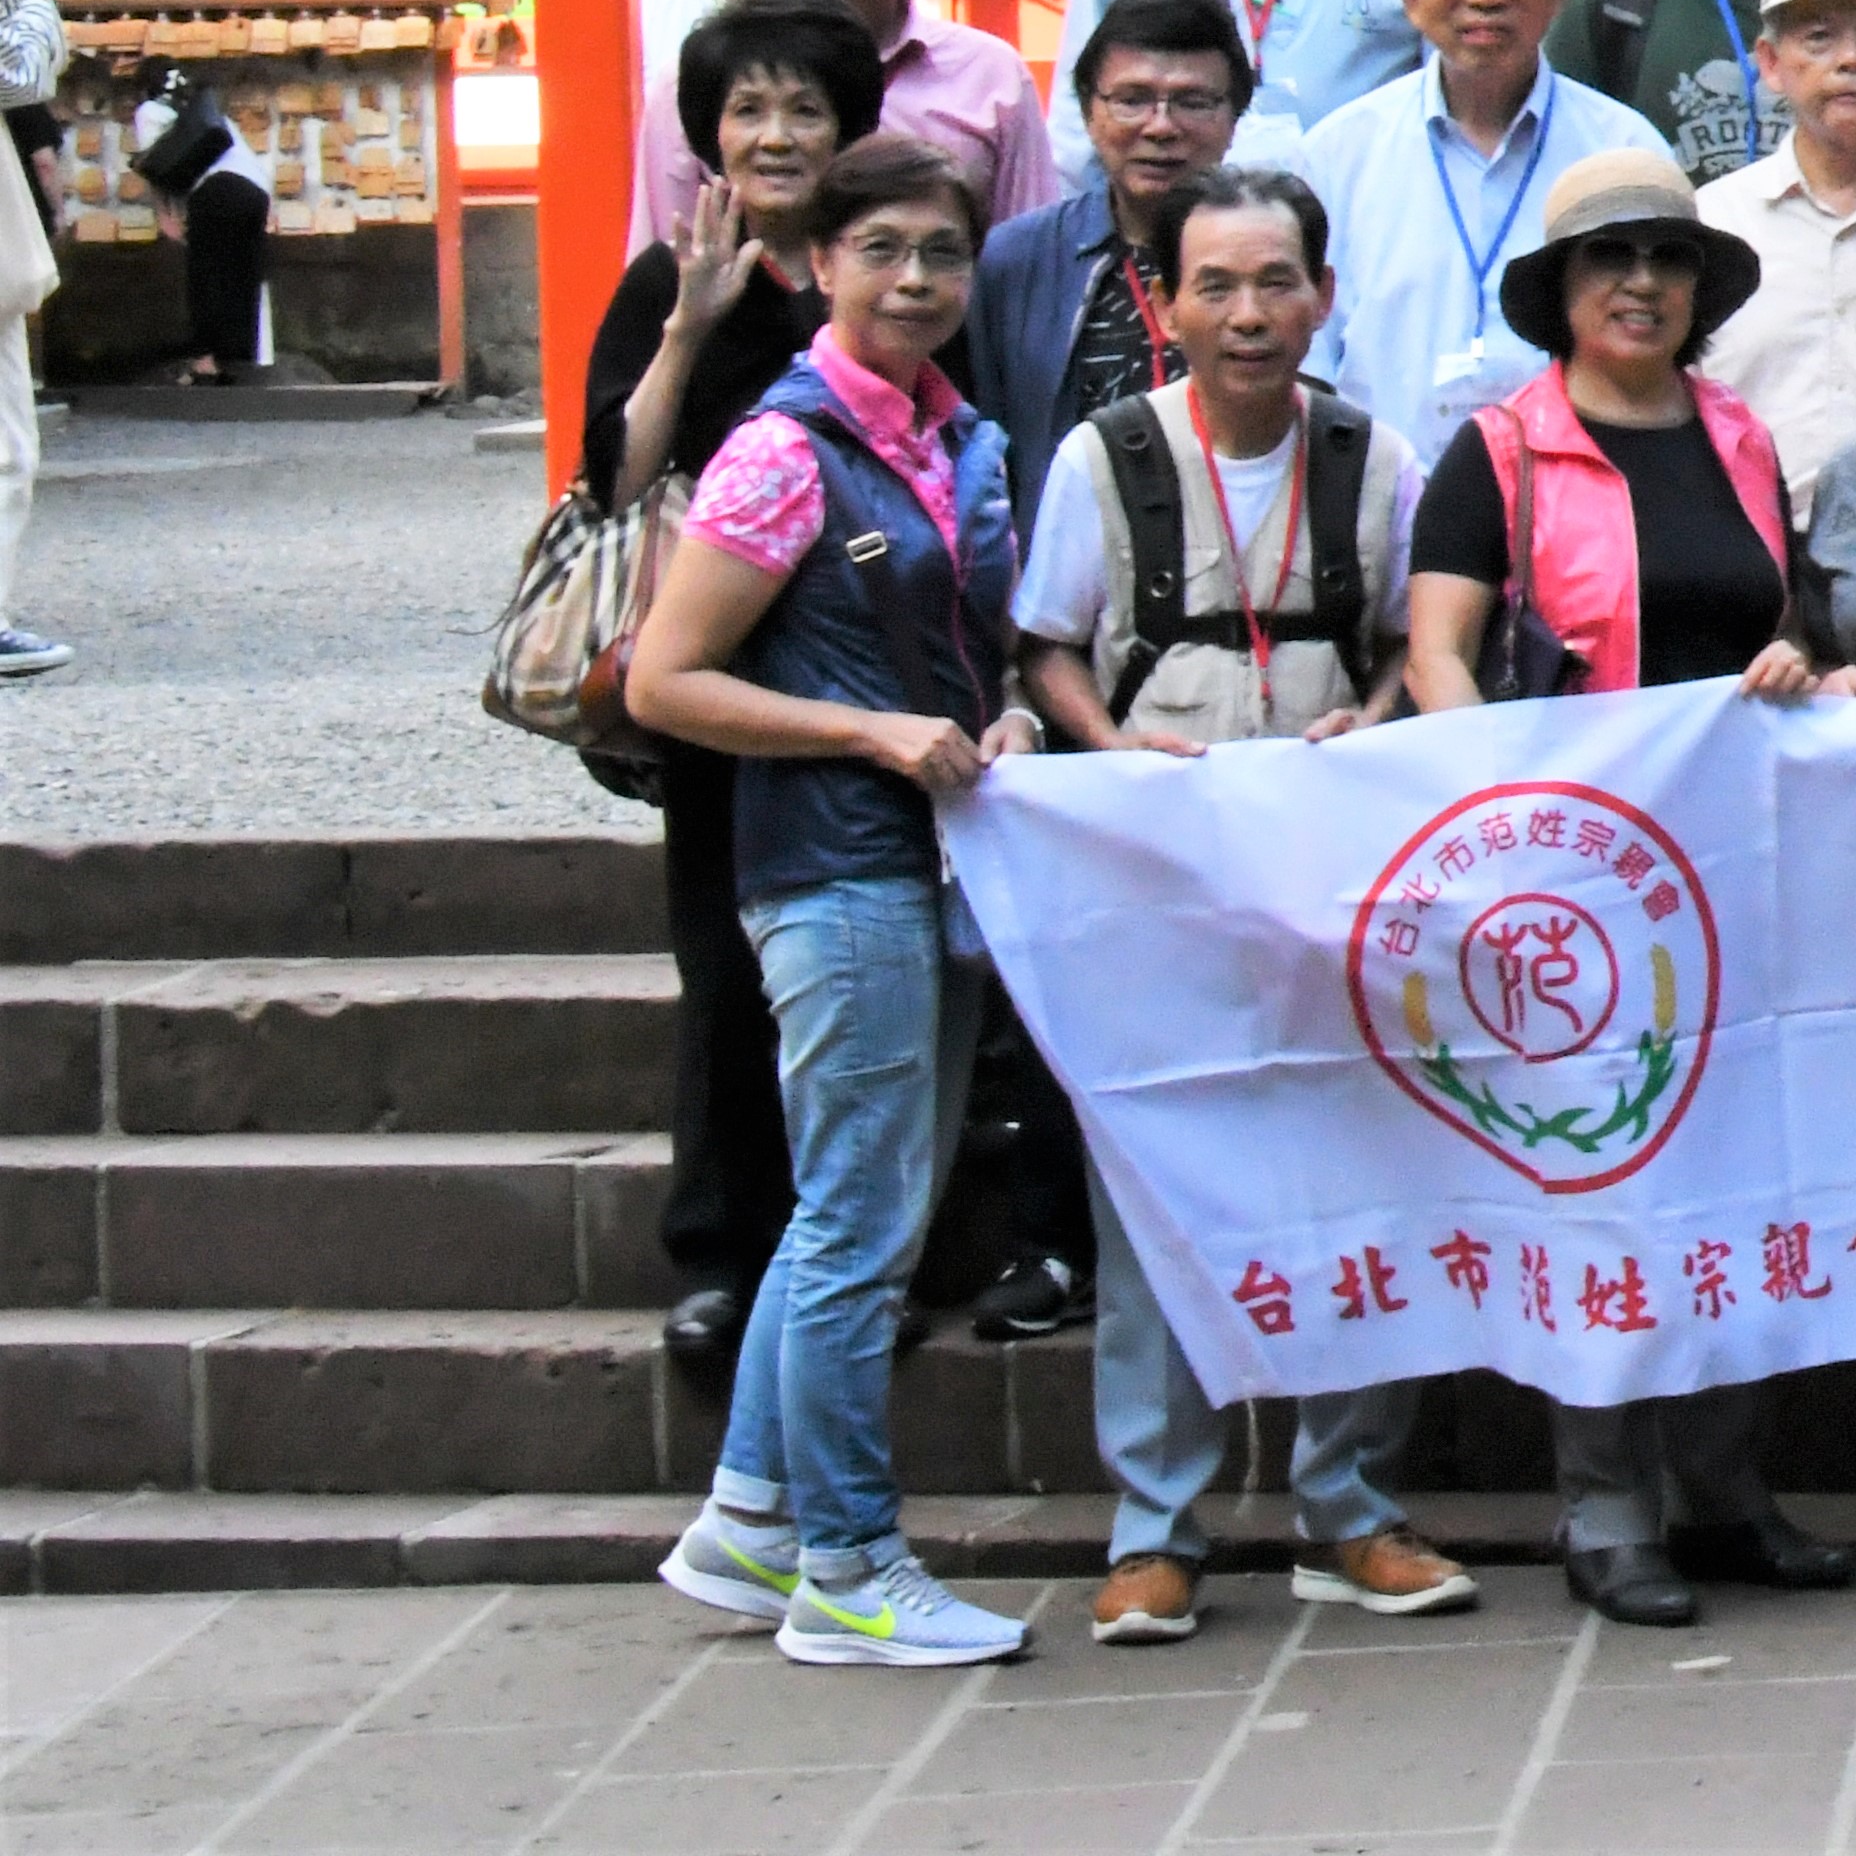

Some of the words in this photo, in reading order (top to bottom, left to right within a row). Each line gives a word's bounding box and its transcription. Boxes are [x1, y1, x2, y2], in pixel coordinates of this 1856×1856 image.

[1690, 118, 1789, 150] ROOT
[1379, 808, 1681, 957] 台北市范姓宗親會
